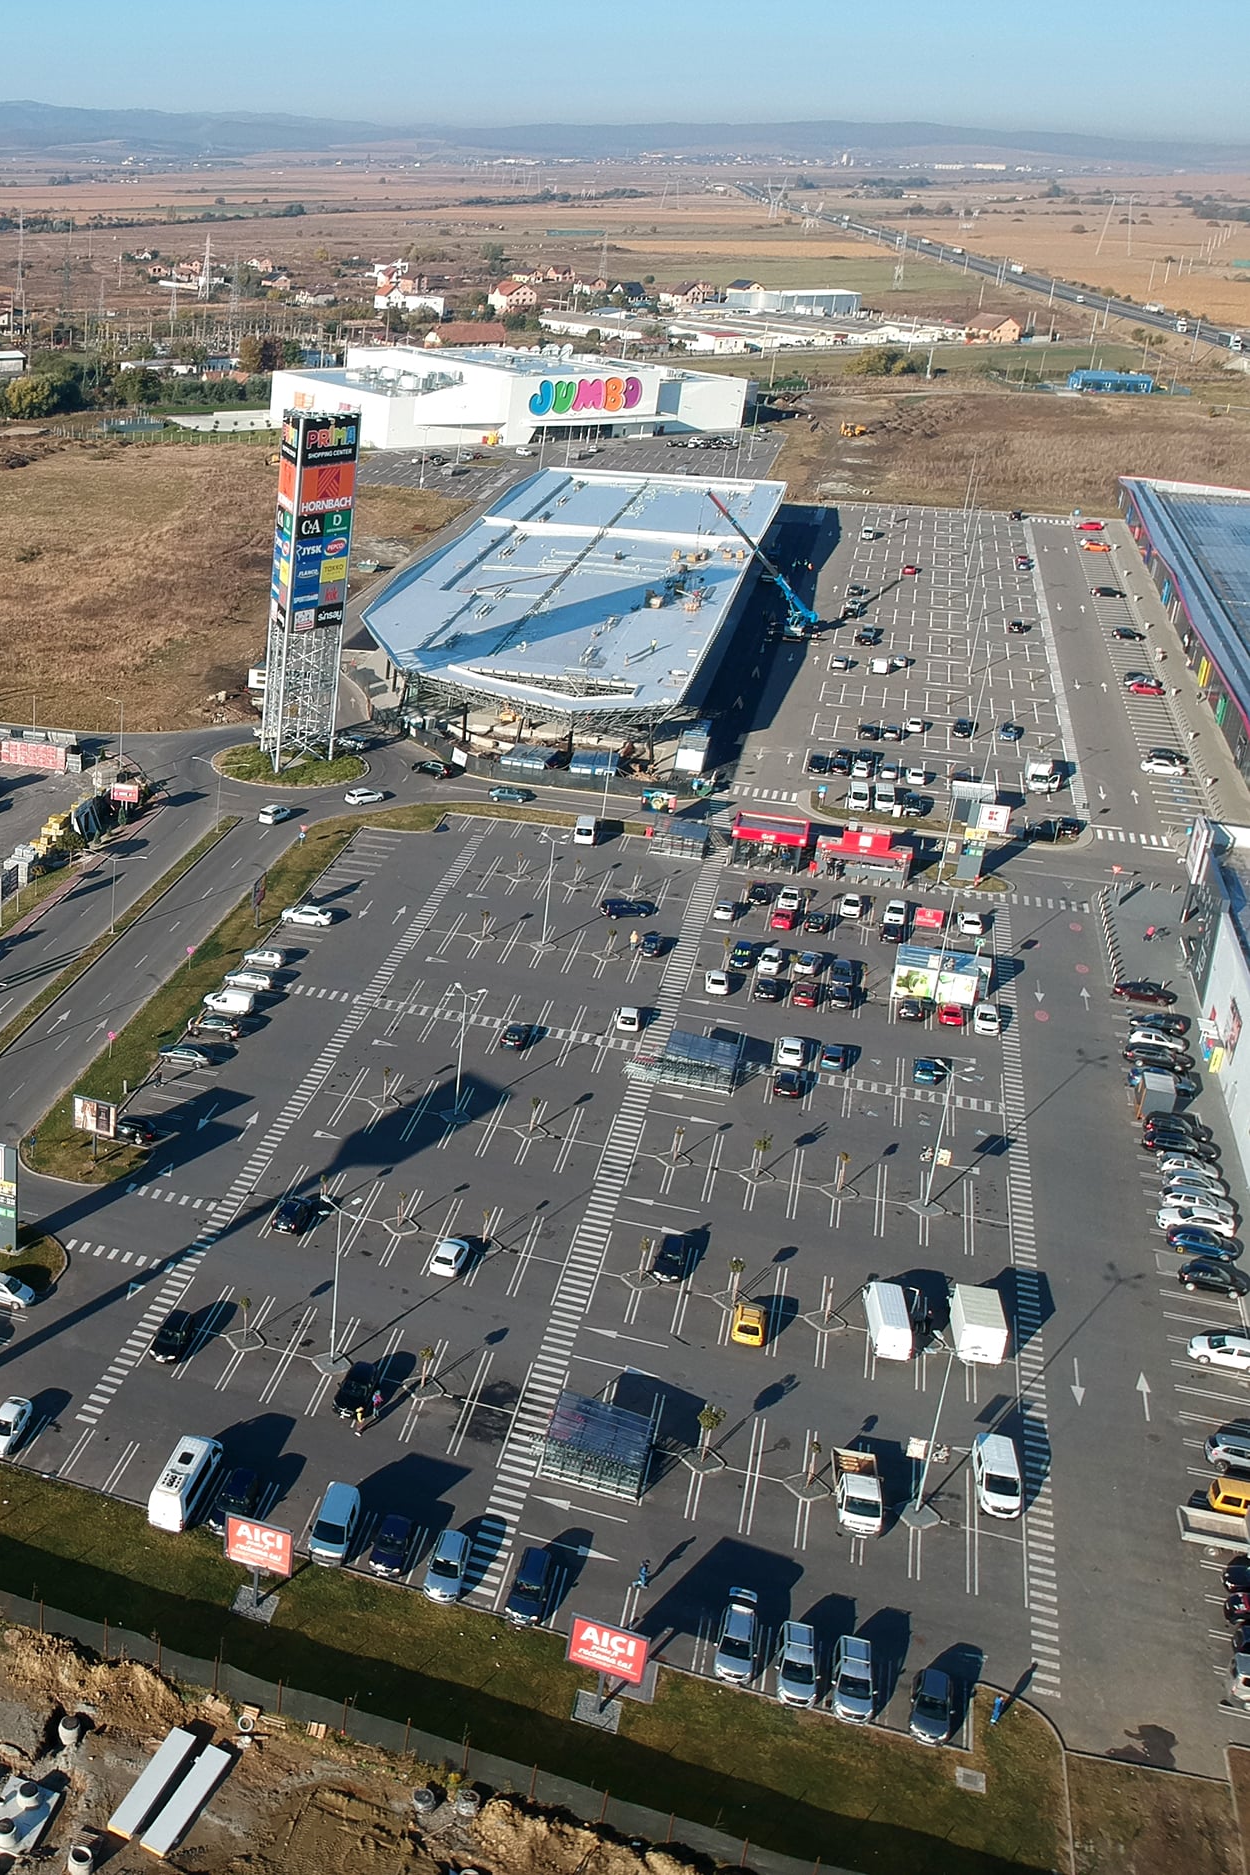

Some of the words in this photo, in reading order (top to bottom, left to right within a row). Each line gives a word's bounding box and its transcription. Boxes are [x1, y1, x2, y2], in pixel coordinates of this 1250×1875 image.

[529, 376, 643, 416] JUMBO
[306, 424, 356, 449] PRIMA
[308, 450, 332, 460] SHOPPING
[333, 448, 352, 457] CENTER
[301, 495, 352, 513] HORNBACH
[301, 544, 322, 556] JYSK
[317, 609, 342, 621] sinsay
[235, 1524, 283, 1550] AICI
[580, 1626, 637, 1657] AICI
